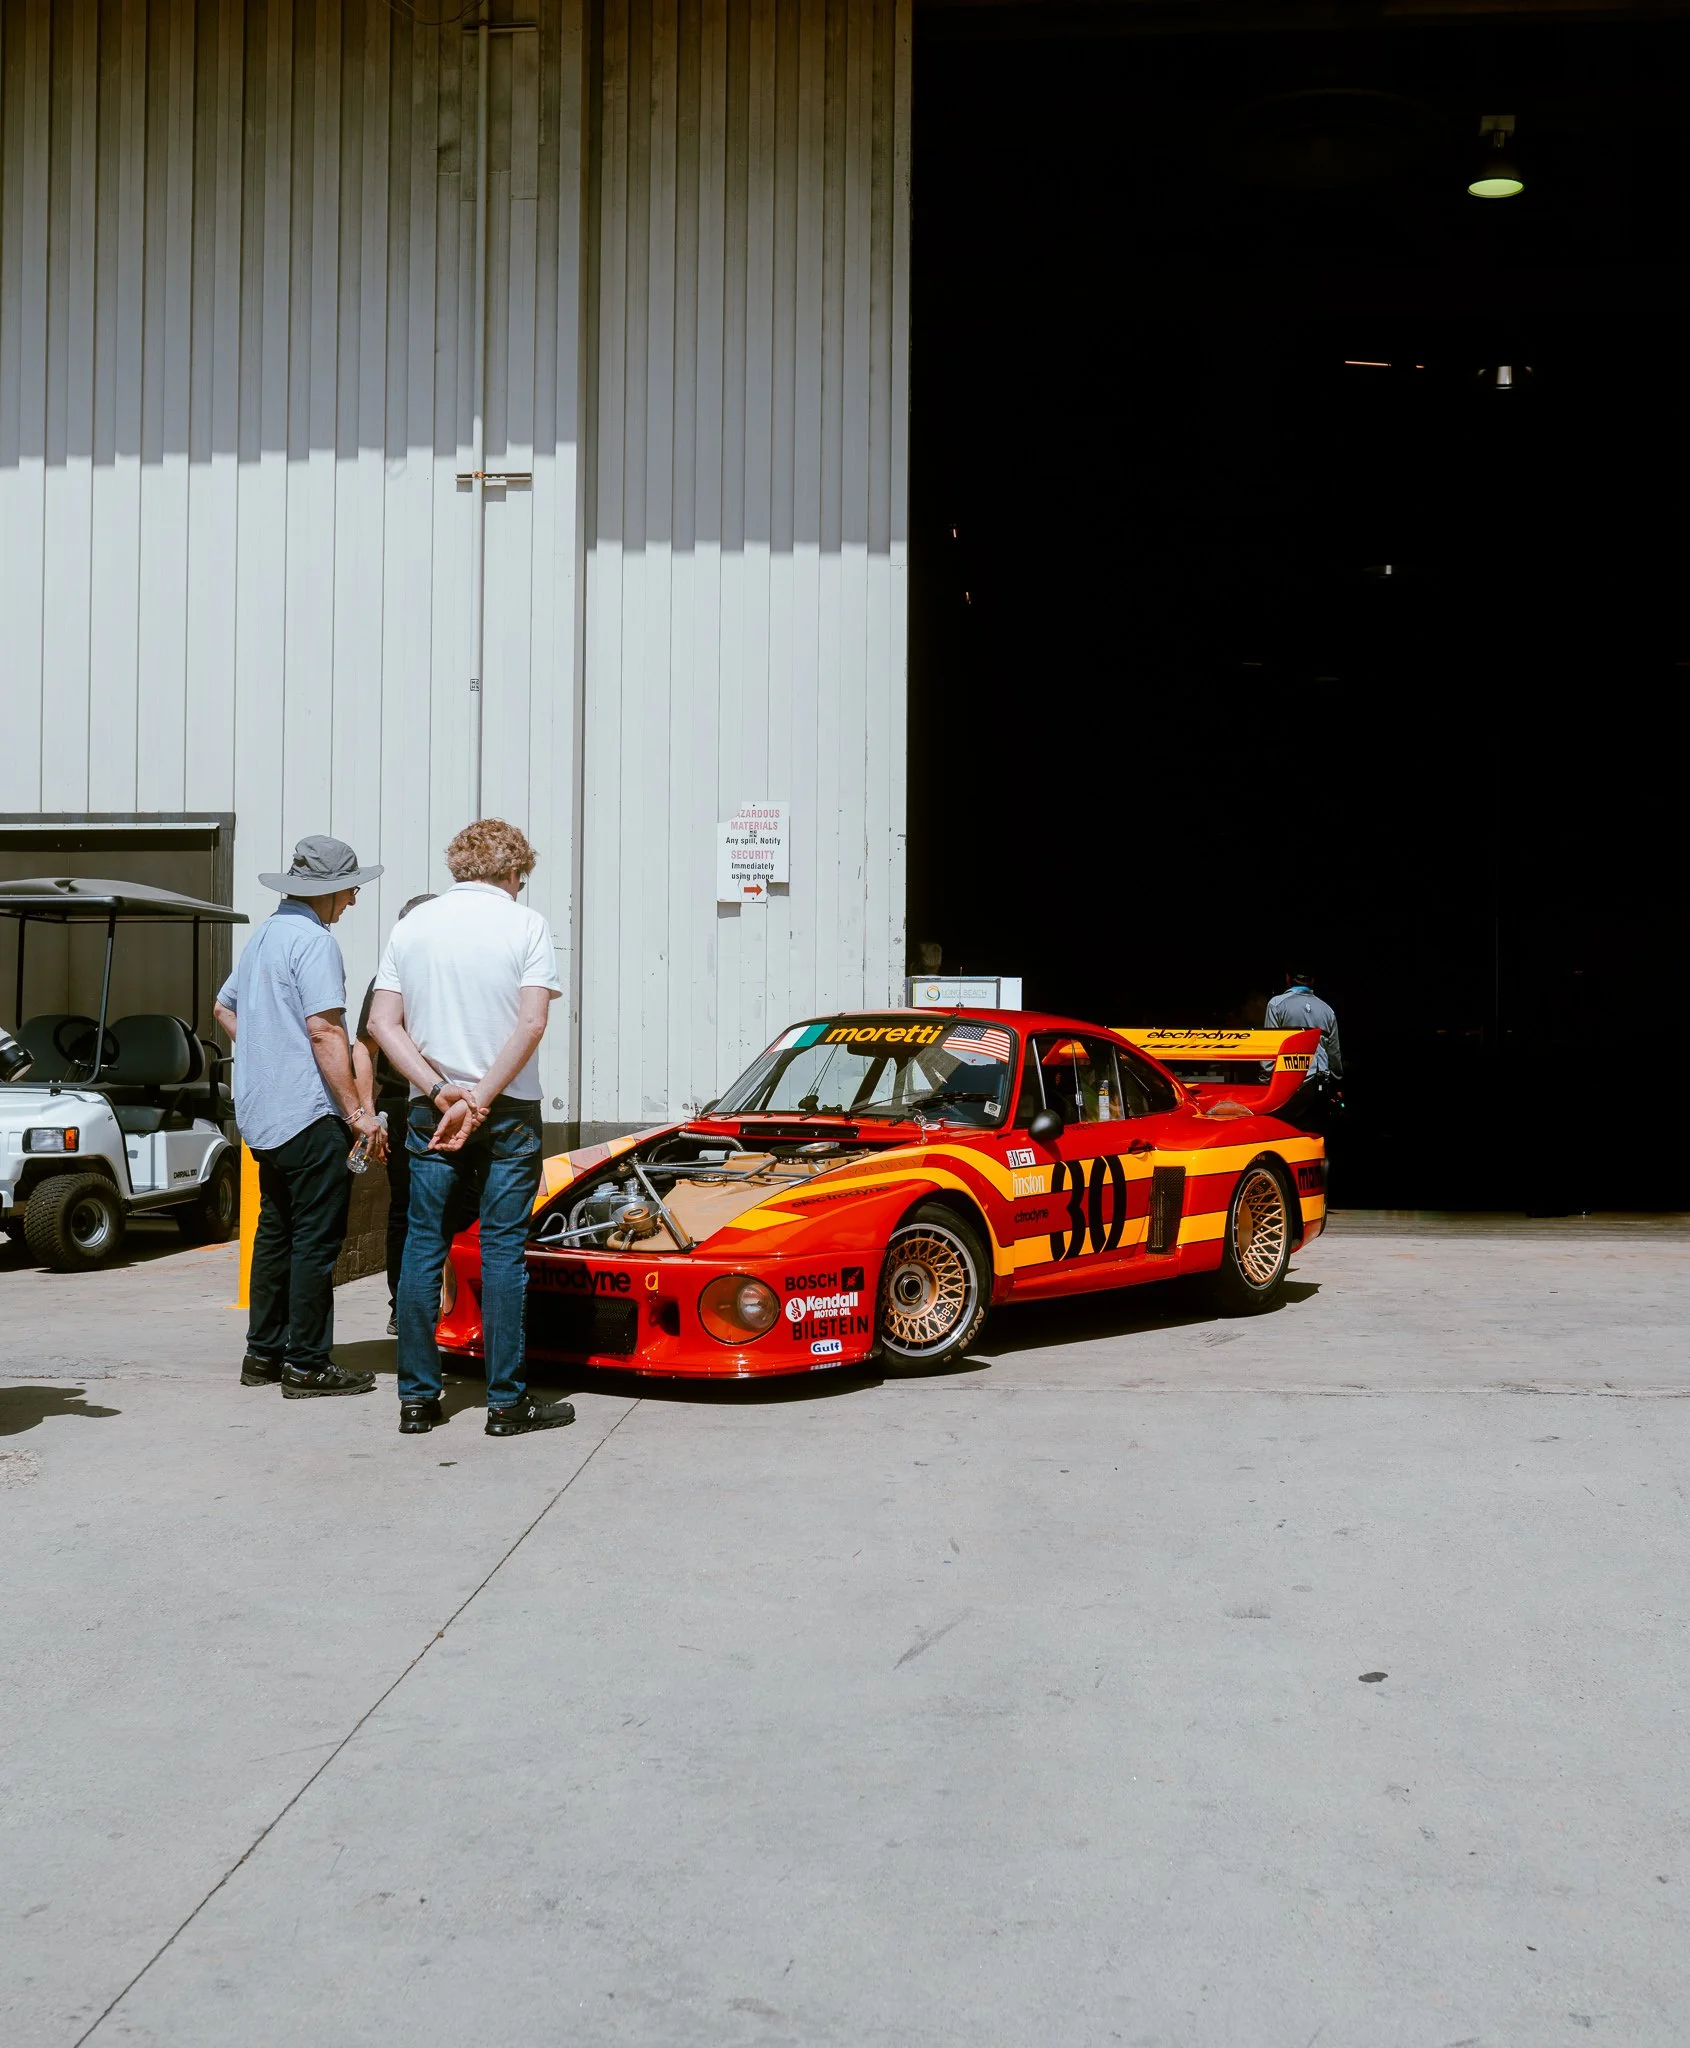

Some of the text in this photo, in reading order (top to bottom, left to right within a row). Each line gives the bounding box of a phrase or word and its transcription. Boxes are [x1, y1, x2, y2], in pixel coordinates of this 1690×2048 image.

[735, 809, 780, 818] AZARDOUS
[730, 821, 778, 831] MATERIALS
[725, 837, 739, 845] Any
[760, 837, 781, 845] Notify
[730, 850, 775, 860] SECURITY
[731, 862, 775, 871] Immediately
[753, 873, 774, 881] phone
[824, 1024, 944, 1045] moretti
[1146, 1029, 1251, 1041] electrodyne
[791, 1185, 890, 1208] electrodyne
[1049, 1155, 1127, 1262] 30
[1014, 1208, 1049, 1224] ctrodyne
[528, 1261, 631, 1297] ctrodyne
[785, 1272, 838, 1292] BOSCH
[806, 1291, 859, 1311] Kendall
[813, 1308, 851, 1319] MOTOR OIL
[792, 1315, 869, 1341] BILSTEIN
[812, 1342, 840, 1353] Gulf
